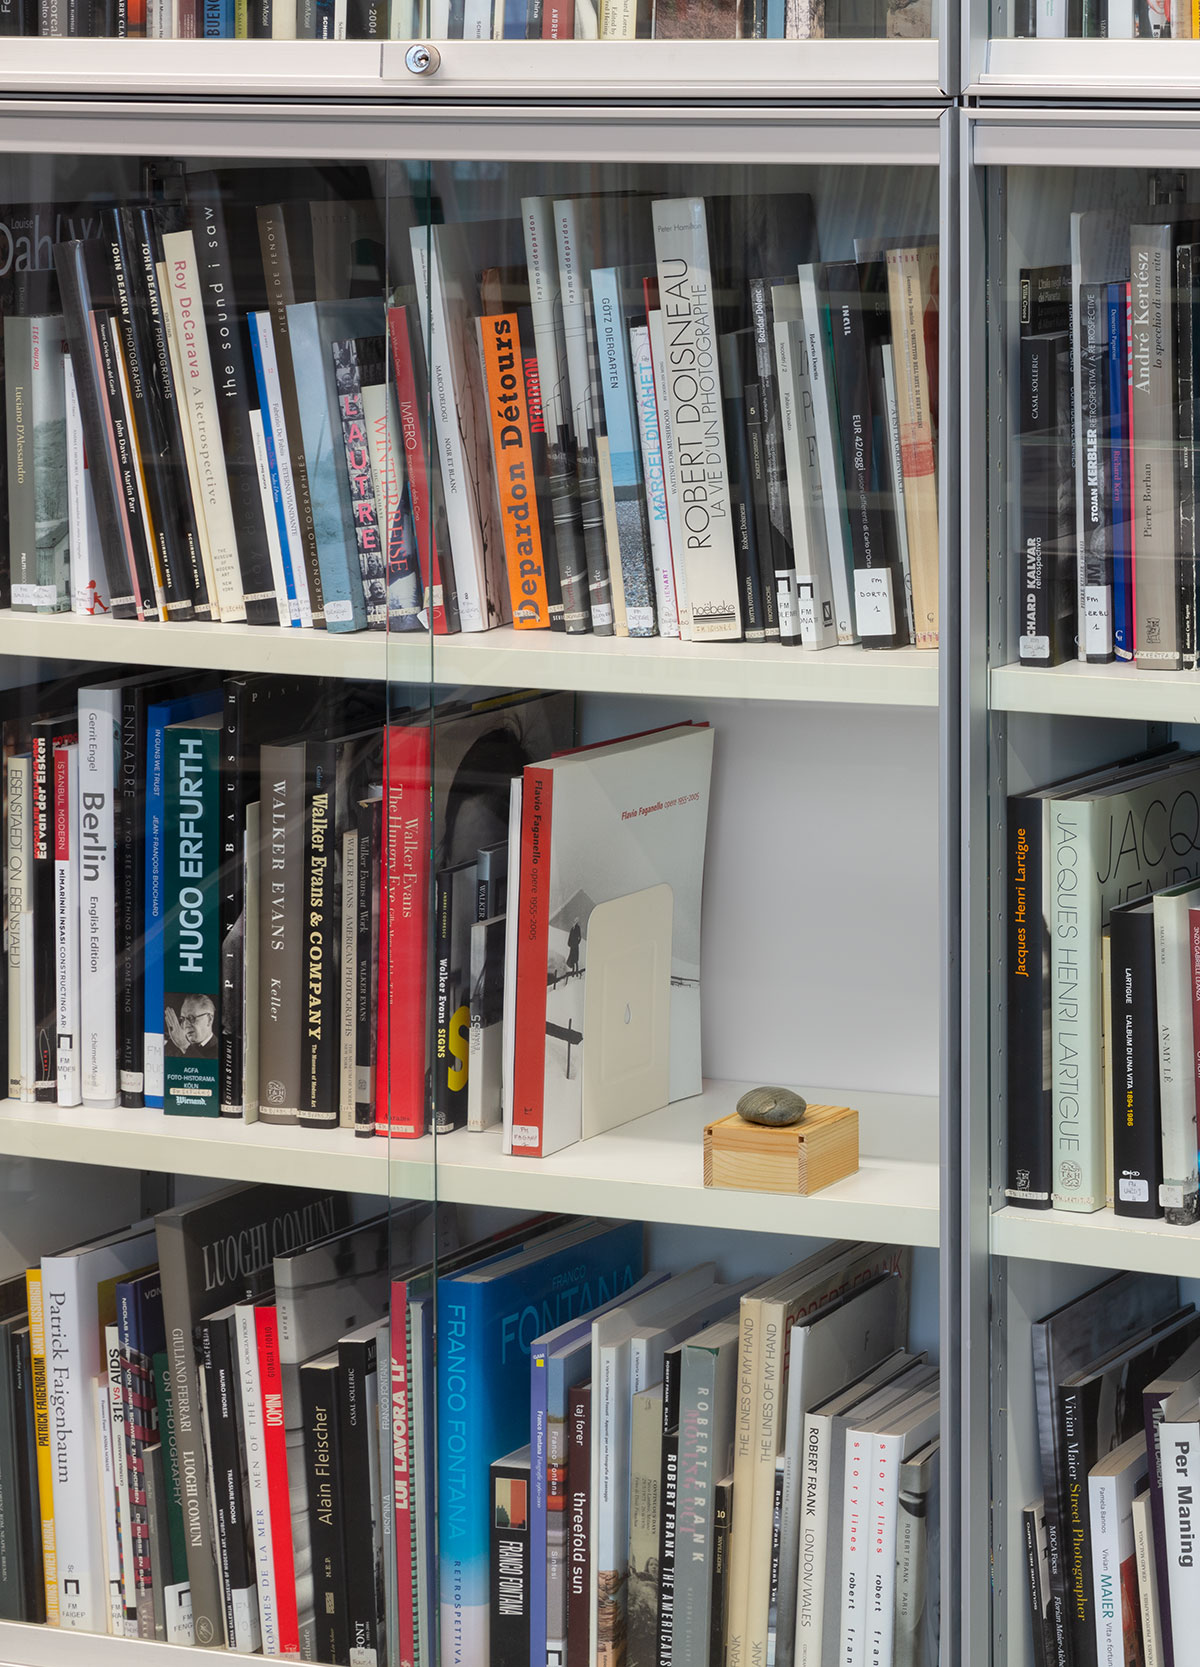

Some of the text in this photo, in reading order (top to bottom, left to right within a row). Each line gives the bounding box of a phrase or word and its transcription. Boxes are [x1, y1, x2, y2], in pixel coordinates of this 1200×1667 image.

[369, 9, 377, 34] 2004
[174, 260, 216, 506] Roy DeCarava A Retrospective
[602, 297, 618, 390] GÖTZ DIERGARTEN
[1134, 252, 1151, 395] André Kertész
[15, 386, 26, 484] Luciano D'Alessandro
[436, 366, 458, 494] MARCO DELOGU NOIR ET BLANC
[662, 258, 712, 550] ROBERT DOISNEAU
[691, 284, 726, 518] LA VIE D'UN PHOTOGRAPHE
[114, 420, 136, 514] John Davies Martin Parr
[494, 320, 542, 623] Depardon Détours
[1143, 463, 1152, 538] Pierre Borhan
[298, 454, 324, 610] CHRONOPHOTOGRAPHIES
[83, 792, 106, 882] Berlin
[179, 738, 204, 973] HUGO ERFURTH
[402, 818, 418, 918] Walker Evans
[528, 780, 544, 941] Flavio Faganello opere 1955-2005
[621, 810, 638, 821] Flavio
[638, 802, 664, 818] Faganello
[664, 799, 678, 810] opere
[88, 896, 98, 973] English Edition
[437, 958, 448, 1058] Walker Evans SIGNS
[50, 1291, 73, 1484] Patrick Faigenbaum
[172, 1328, 202, 1548] GIULIANO FERRARI LUOGHI COMUNI
[448, 1304, 466, 1540] FRANCO FONTANA
[575, 1404, 585, 1446] taj forer
[312, 1406, 333, 1526] Alain Fleischer
[800, 1427, 819, 1628] ROBERT FRANK LONDON/WALES
[1064, 1394, 1086, 1622] Vivian Maier Street Photographer
[1175, 1441, 1194, 1568] Per Maning
[256, 1508, 276, 1656] HOMMES DE LA MER
[660, 1454, 677, 1667] ROBERT FRANK THE AMERICANS
[902, 1556, 910, 1584] FRANK
[1100, 1574, 1114, 1619] MAIER
